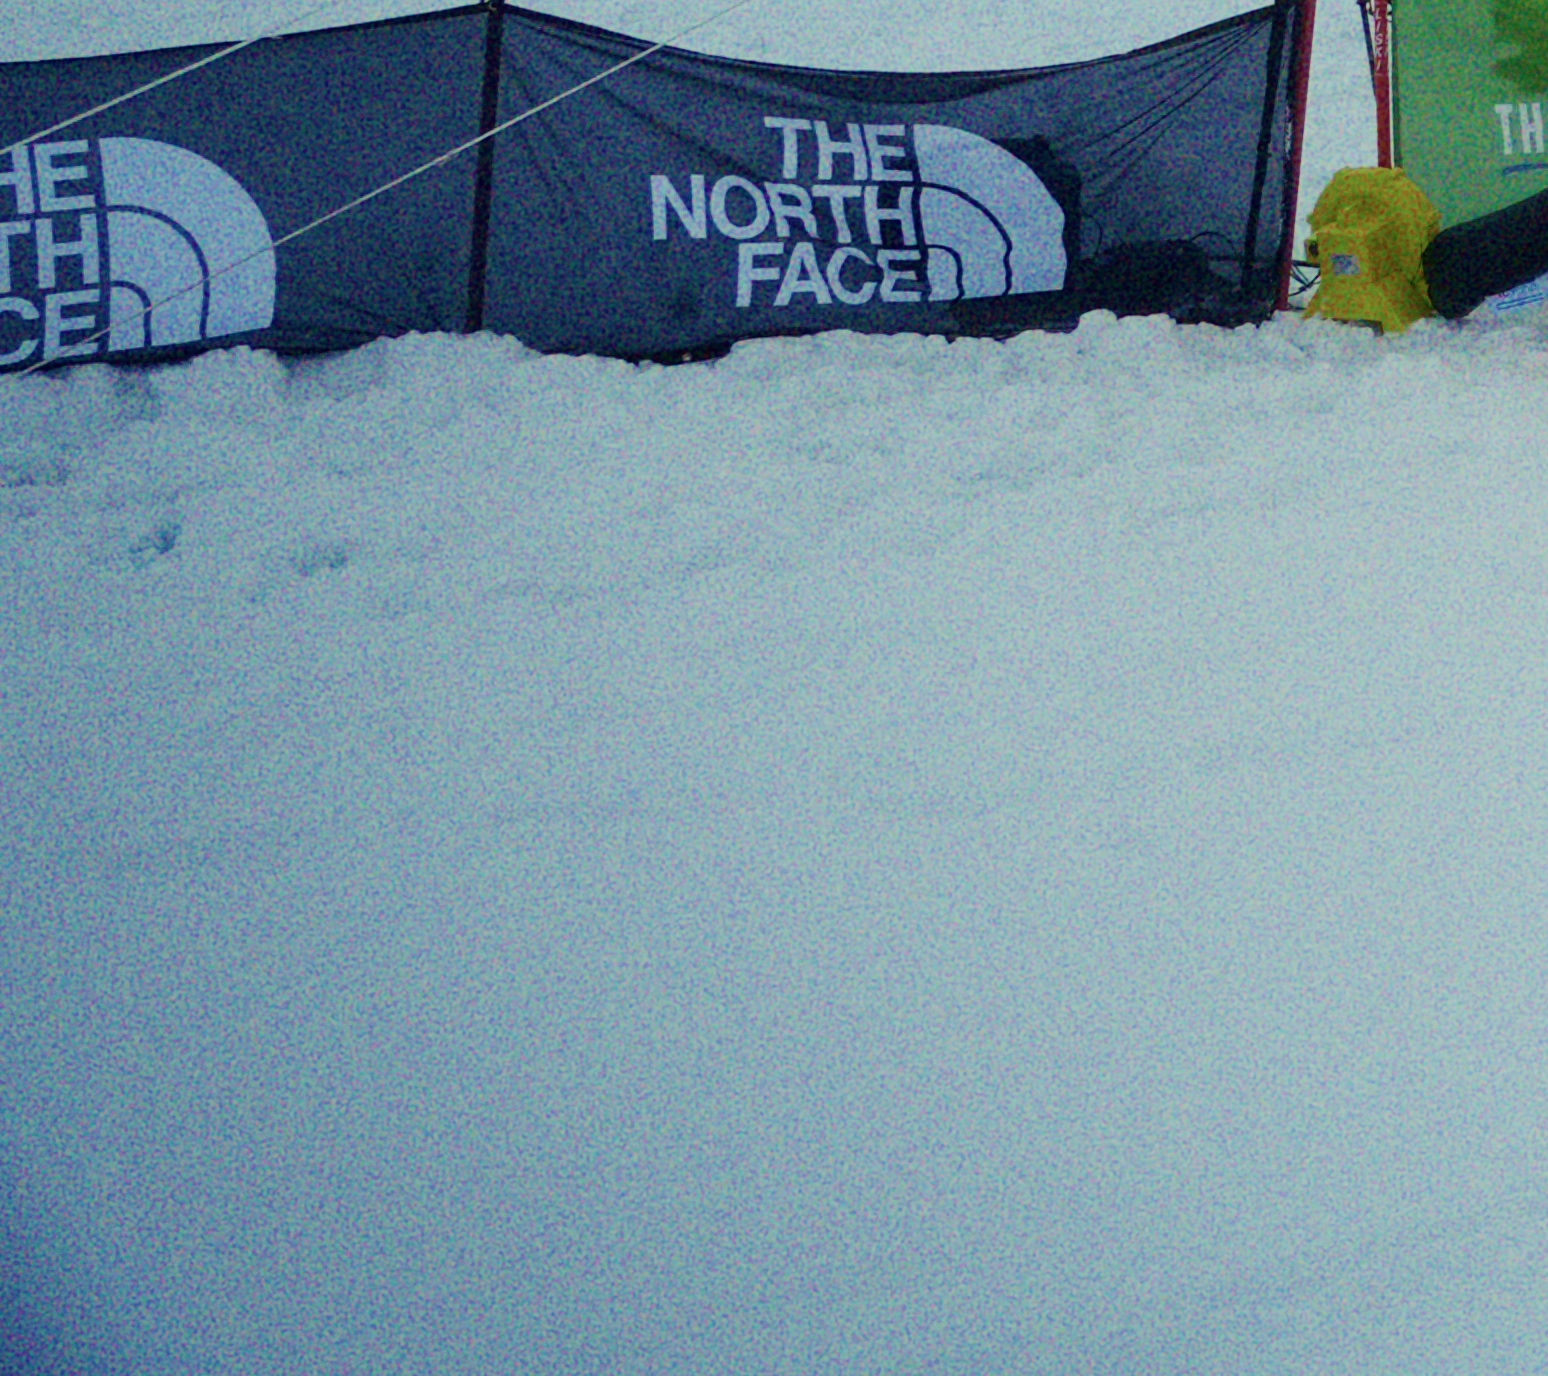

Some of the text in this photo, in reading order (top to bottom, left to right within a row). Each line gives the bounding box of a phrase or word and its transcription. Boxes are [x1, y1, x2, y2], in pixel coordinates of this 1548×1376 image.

[0, 139, 96, 215] HE
[764, 116, 914, 182] THE
[650, 174, 918, 245] NORTH
[735, 241, 923, 307] FACE
[0, 289, 101, 365] CE
